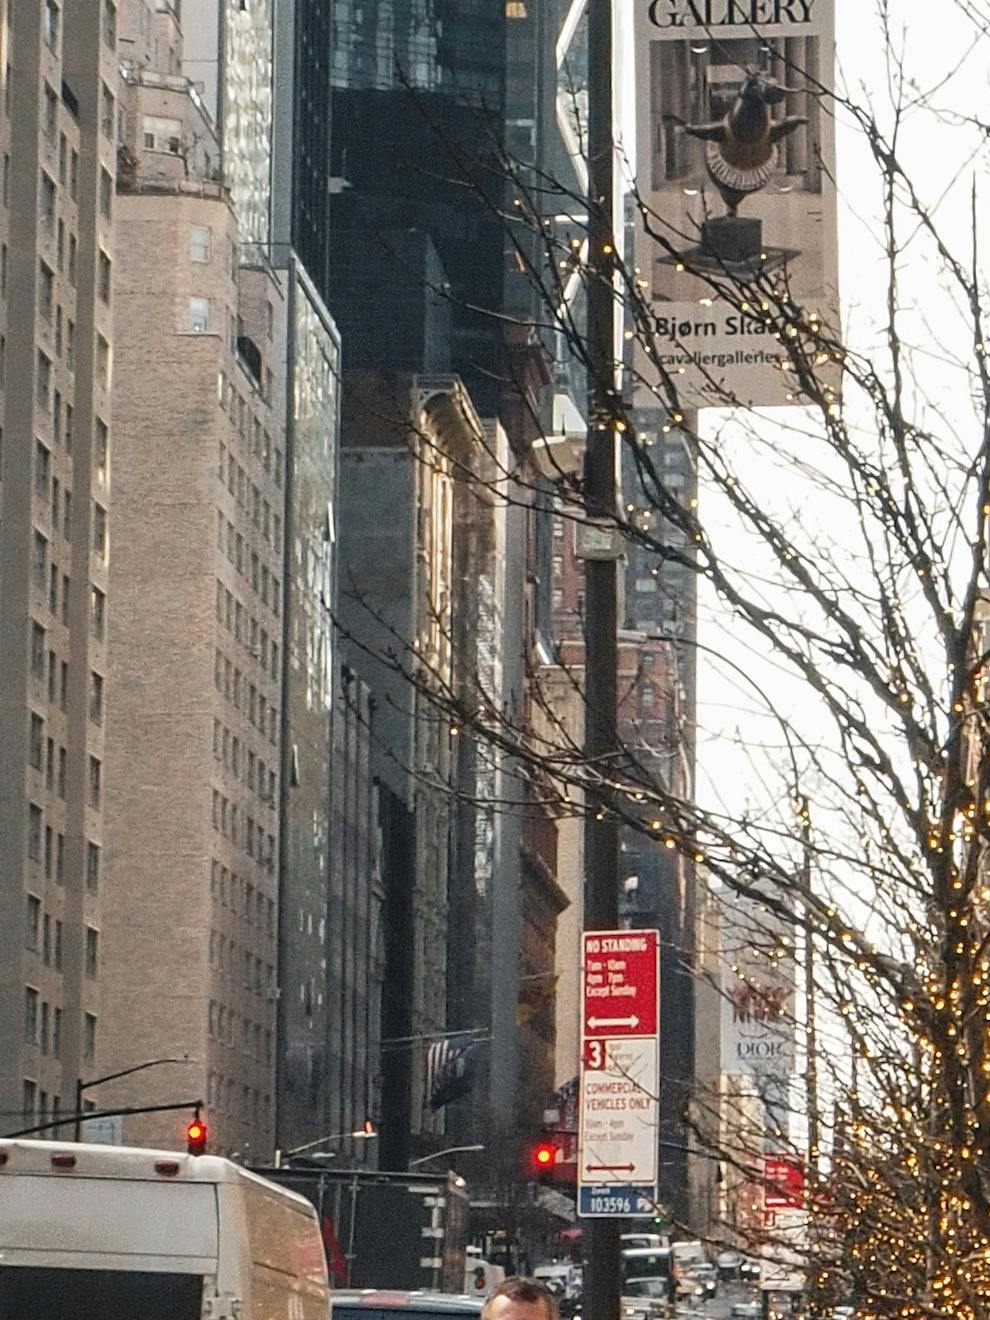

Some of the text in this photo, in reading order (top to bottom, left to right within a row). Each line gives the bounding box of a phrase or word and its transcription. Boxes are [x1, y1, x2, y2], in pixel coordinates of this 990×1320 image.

[648, 0, 816, 28] GALLERY
[656, 317, 717, 342] Bjørn
[586, 938, 648, 953] NO STANDING
[588, 1041, 601, 1069] 3
[586, 1082, 642, 1095] COMMERCIAL
[585, 1097, 652, 1112] VEHICLES ONLY
[590, 1197, 631, 1213] 103596
